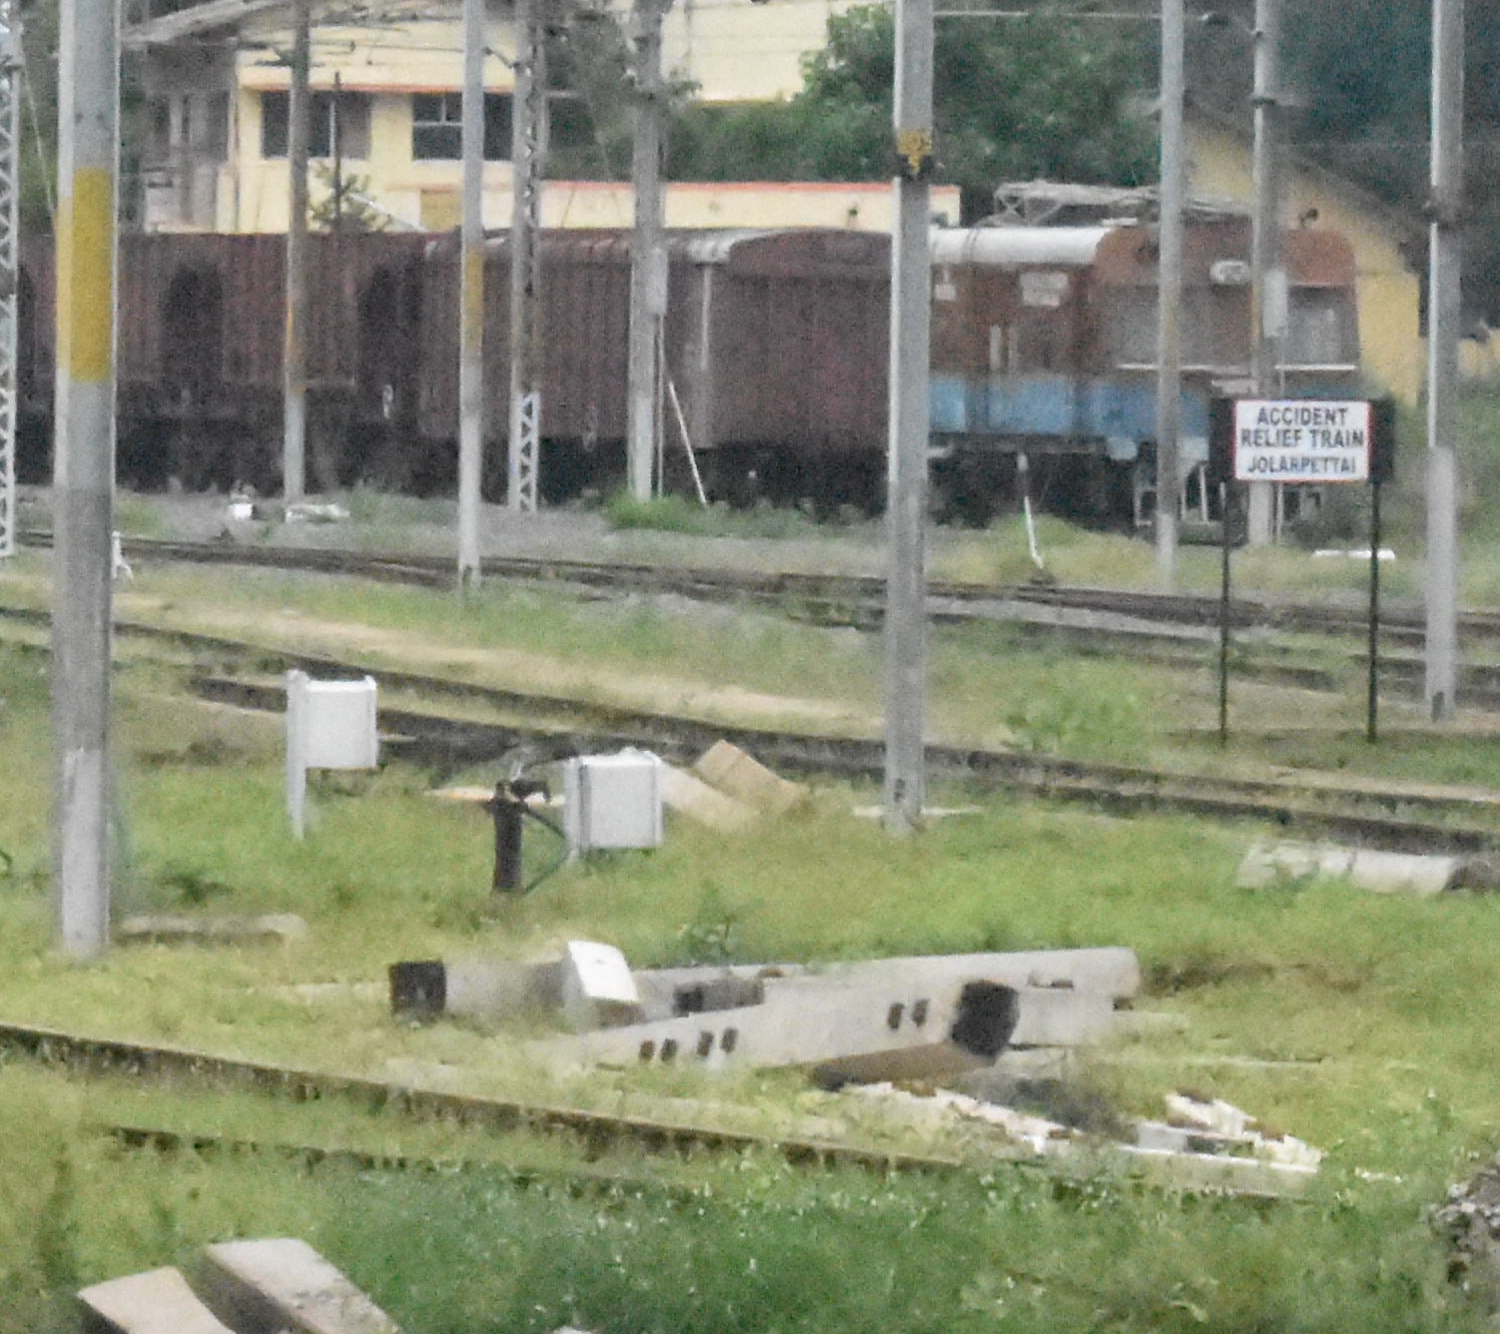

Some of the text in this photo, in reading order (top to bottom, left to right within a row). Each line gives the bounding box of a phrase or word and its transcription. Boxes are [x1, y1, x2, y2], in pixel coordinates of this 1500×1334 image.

[1256, 407, 1349, 426] ACCIDENT
[1241, 428, 1364, 447] RELIEF TRAIN
[1247, 456, 1356, 474] JOLARPETTAI
